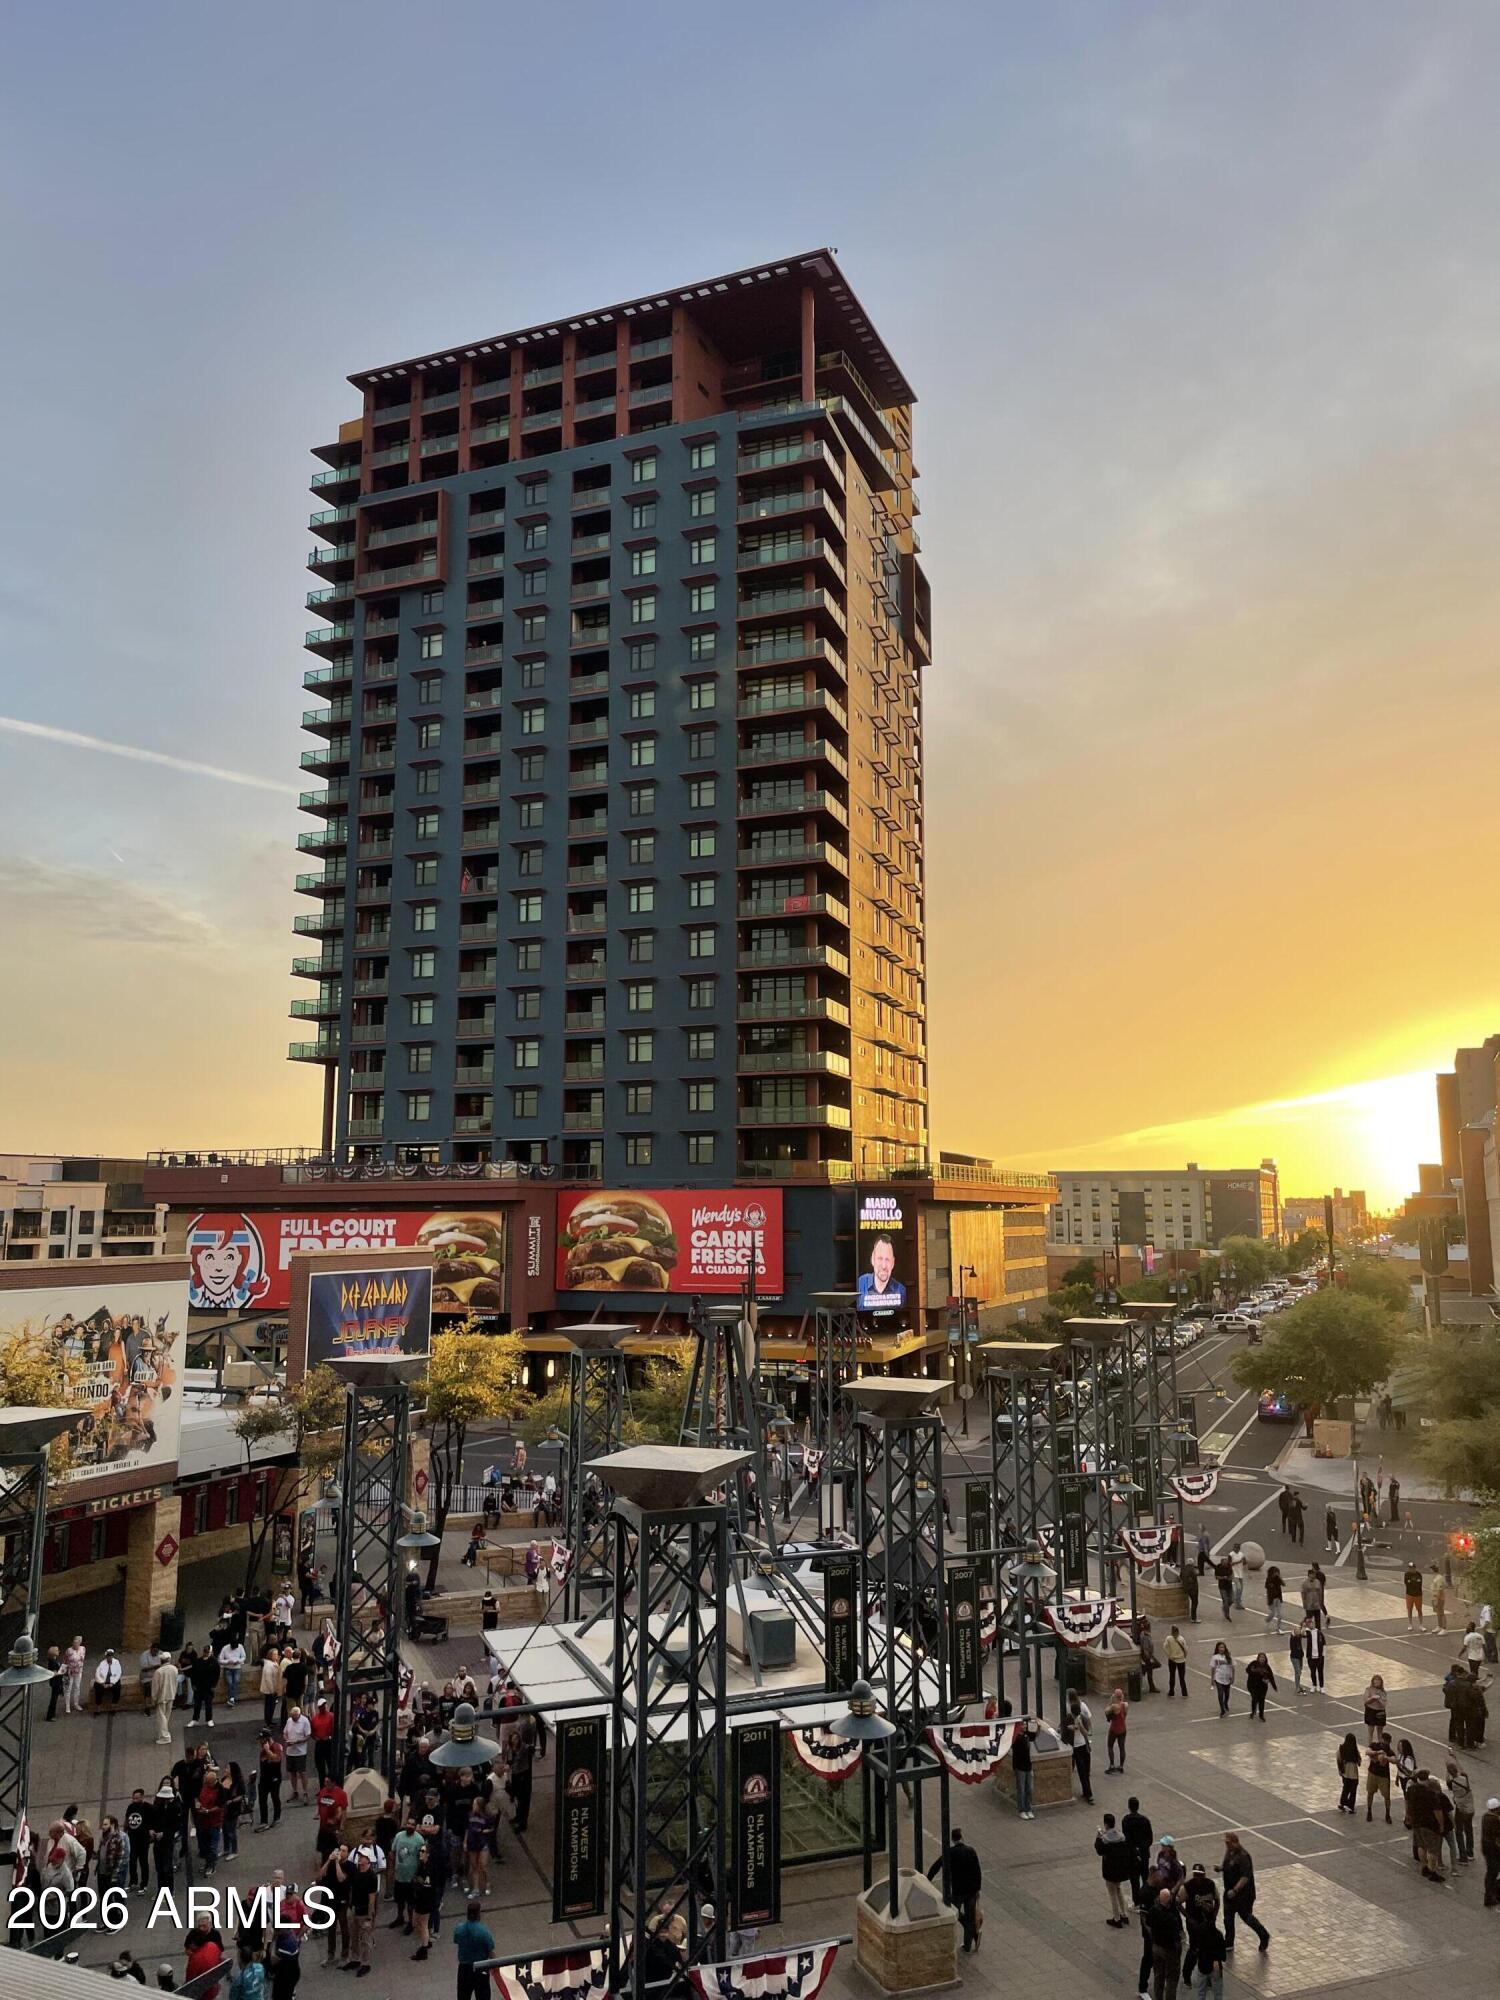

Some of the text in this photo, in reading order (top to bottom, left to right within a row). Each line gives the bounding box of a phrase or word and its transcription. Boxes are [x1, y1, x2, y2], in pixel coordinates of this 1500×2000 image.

[865, 1197, 897, 1209] MARIO
[691, 1204, 742, 1228] Wendy's
[860, 1209, 903, 1220] MURILLO
[280, 1218, 397, 1237] FULL-COURT
[691, 1230, 764, 1248] CARNE
[527, 1227, 536, 1277] SUMMIT
[691, 1248, 765, 1265] FRESCA
[690, 1265, 704, 1274] AL
[341, 1277, 408, 1312] DEF LEPPARD
[332, 1316, 409, 1345] JOURNEY
[91, 1488, 162, 1513] TICKETS
[831, 1568, 849, 1577] 2007
[954, 1571, 973, 1580] 2007
[568, 1725, 593, 1737] 2011
[743, 1730, 767, 1743] 2011
[580, 1807, 589, 1860] NL WEST
[756, 1814, 765, 1867] NL WEST
[569, 1808, 579, 1881] CHAMPIONS
[747, 1815, 755, 1889] CHAMPIONS
